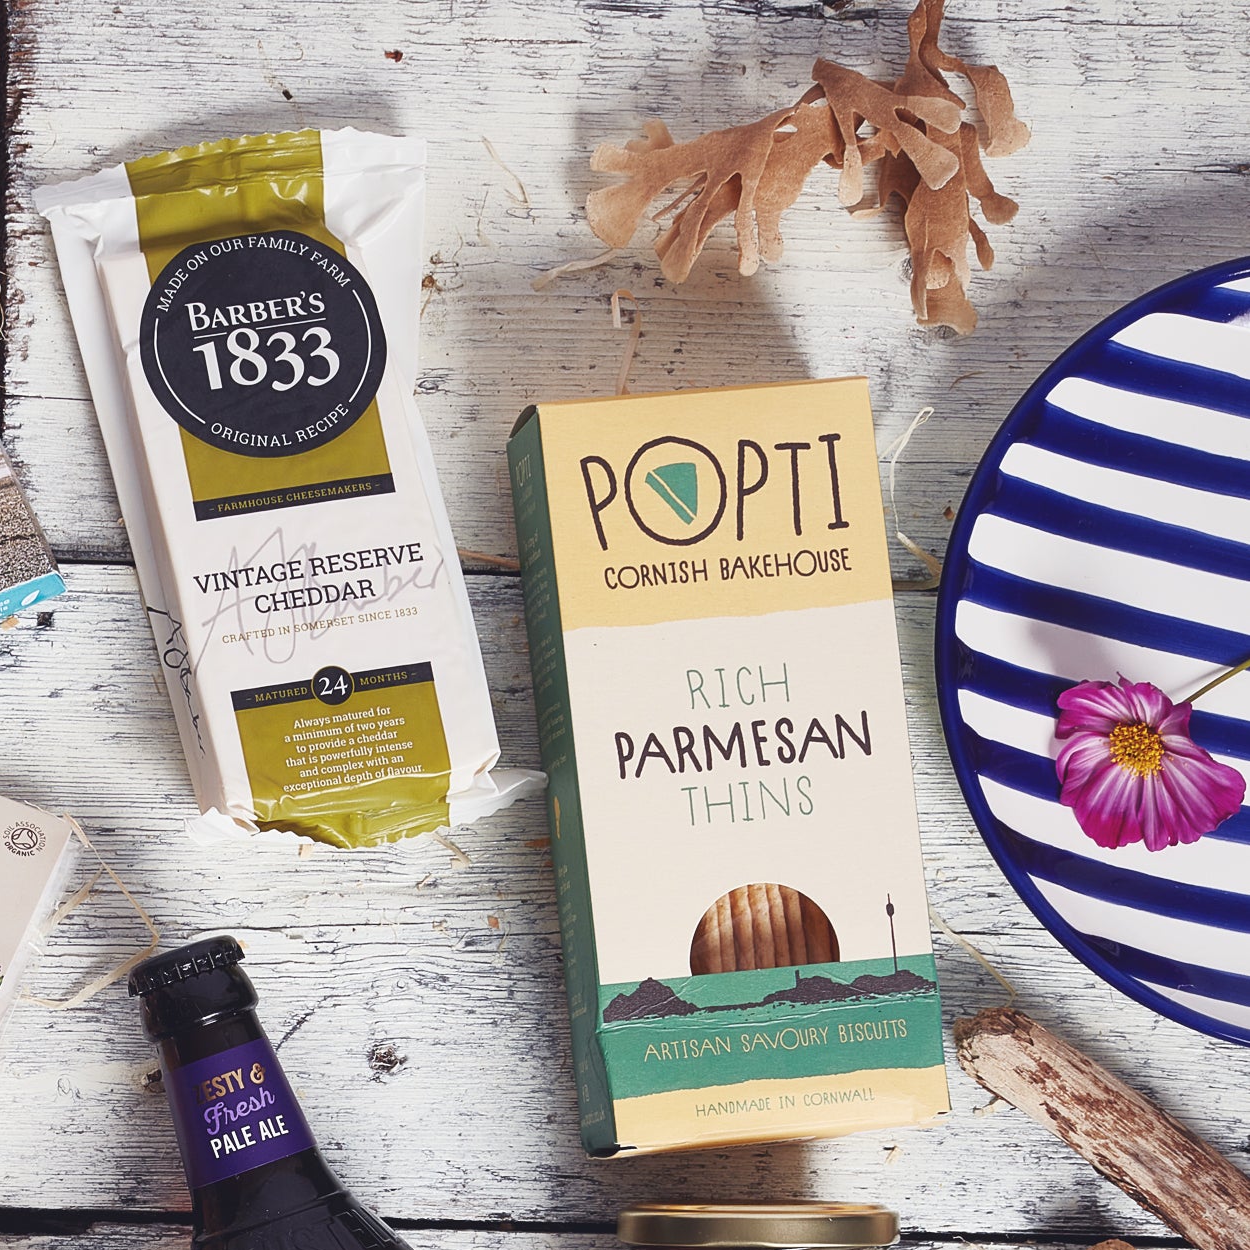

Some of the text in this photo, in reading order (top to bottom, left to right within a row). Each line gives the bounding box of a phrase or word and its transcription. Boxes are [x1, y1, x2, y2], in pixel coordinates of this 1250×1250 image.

[157, 236, 351, 312] MADE ON OUR FAMILY FARM
[192, 326, 340, 392] 1833
[210, 403, 349, 447] ORIGINAL RECIPE
[217, 482, 372, 513] FARMHOUSE CHEESEMAKERS
[580, 433, 850, 551] POPTI
[193, 542, 424, 594] VINTAGE RESERVE
[603, 548, 852, 590] CORNISH BAKEHOUSE
[254, 579, 376, 614] CHEDDAR
[222, 606, 418, 644] CRAFTED IN SOMERSET SINCE 1833
[255, 671, 408, 702] MATURED 24 MONTHS
[686, 663, 790, 710] RICH
[284, 717, 406, 743] a minimum of two years
[293, 706, 391, 730] Always matured for
[285, 740, 413, 768] that is powerfully intense
[296, 730, 398, 755] to provide a cheddar
[613, 710, 872, 780] PARMESAN
[680, 775, 814, 826] THINS
[643, 1018, 908, 1063] ARTISAN SAVOURY BISCUITS
[250, 1063, 266, 1085] &
[204, 1087, 275, 1136] Fresh
[695, 1087, 876, 1118] HANDMADE IN CORNWALL
[210, 1114, 289, 1159] PALE ALE
